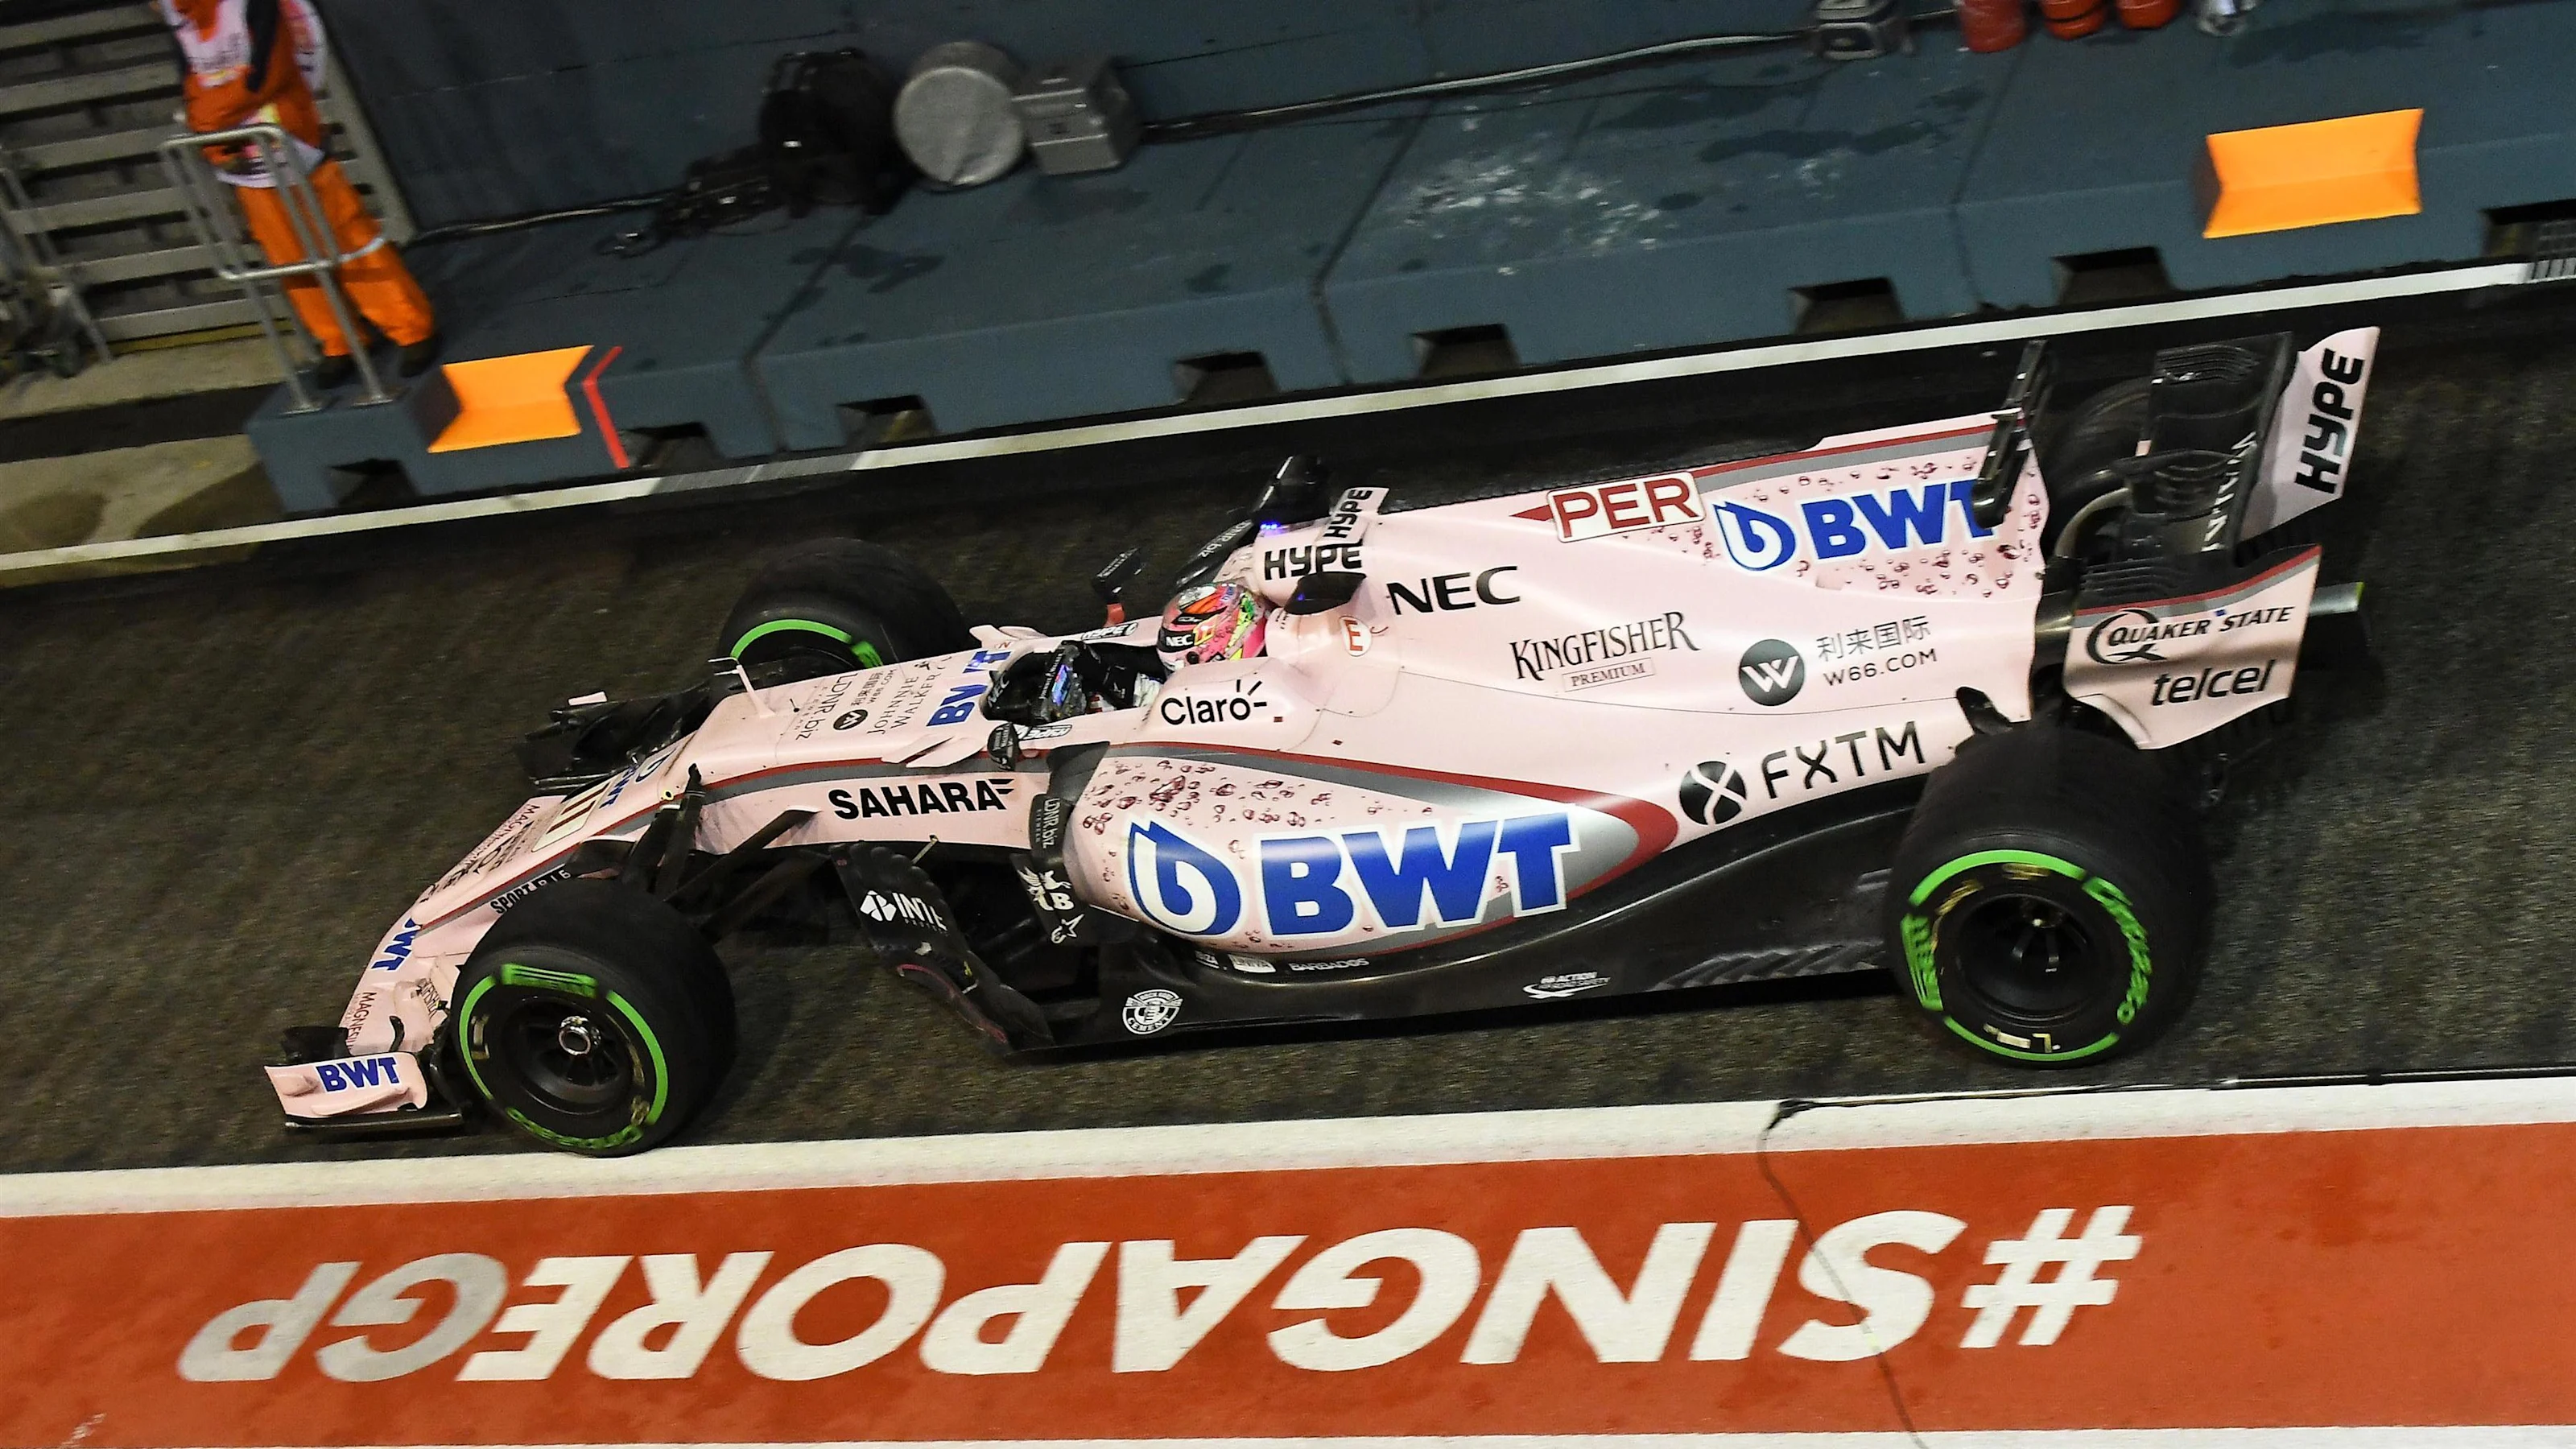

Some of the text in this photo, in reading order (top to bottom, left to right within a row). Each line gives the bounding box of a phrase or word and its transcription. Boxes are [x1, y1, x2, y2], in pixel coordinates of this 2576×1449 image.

[2293, 348, 2365, 495] HYPE
[1323, 489, 1373, 539] HYPE
[1554, 478, 1695, 538] PER
[1802, 480, 1993, 559] BWT
[1265, 545, 1363, 581] HYPE
[1387, 566, 1521, 615] NEC
[1166, 634, 1194, 647] NEC
[1344, 619, 1363, 651] E
[1509, 611, 1701, 681] KINGFISHER
[1816, 615, 1930, 662] 利来国际
[2107, 606, 2295, 646] QUAKER STATE
[1571, 663, 1645, 687] PREMIUM
[1823, 648, 1937, 686] W66.COM
[2151, 658, 2277, 706] telcel
[867, 675, 919, 735] JOHNNIE
[890, 671, 942, 730] WALKER
[1161, 691, 1254, 725] Claro
[1761, 720, 1927, 798] FXTM
[828, 779, 1008, 820] SAHARA
[1042, 798, 1061, 849] LDNR.biz
[1260, 811, 1571, 936] BWT
[1289, 957, 1370, 972] BARBADOS
[316, 1056, 399, 1093] BWT
[177, 1205, 2143, 1382] #SINGAPOREGP
